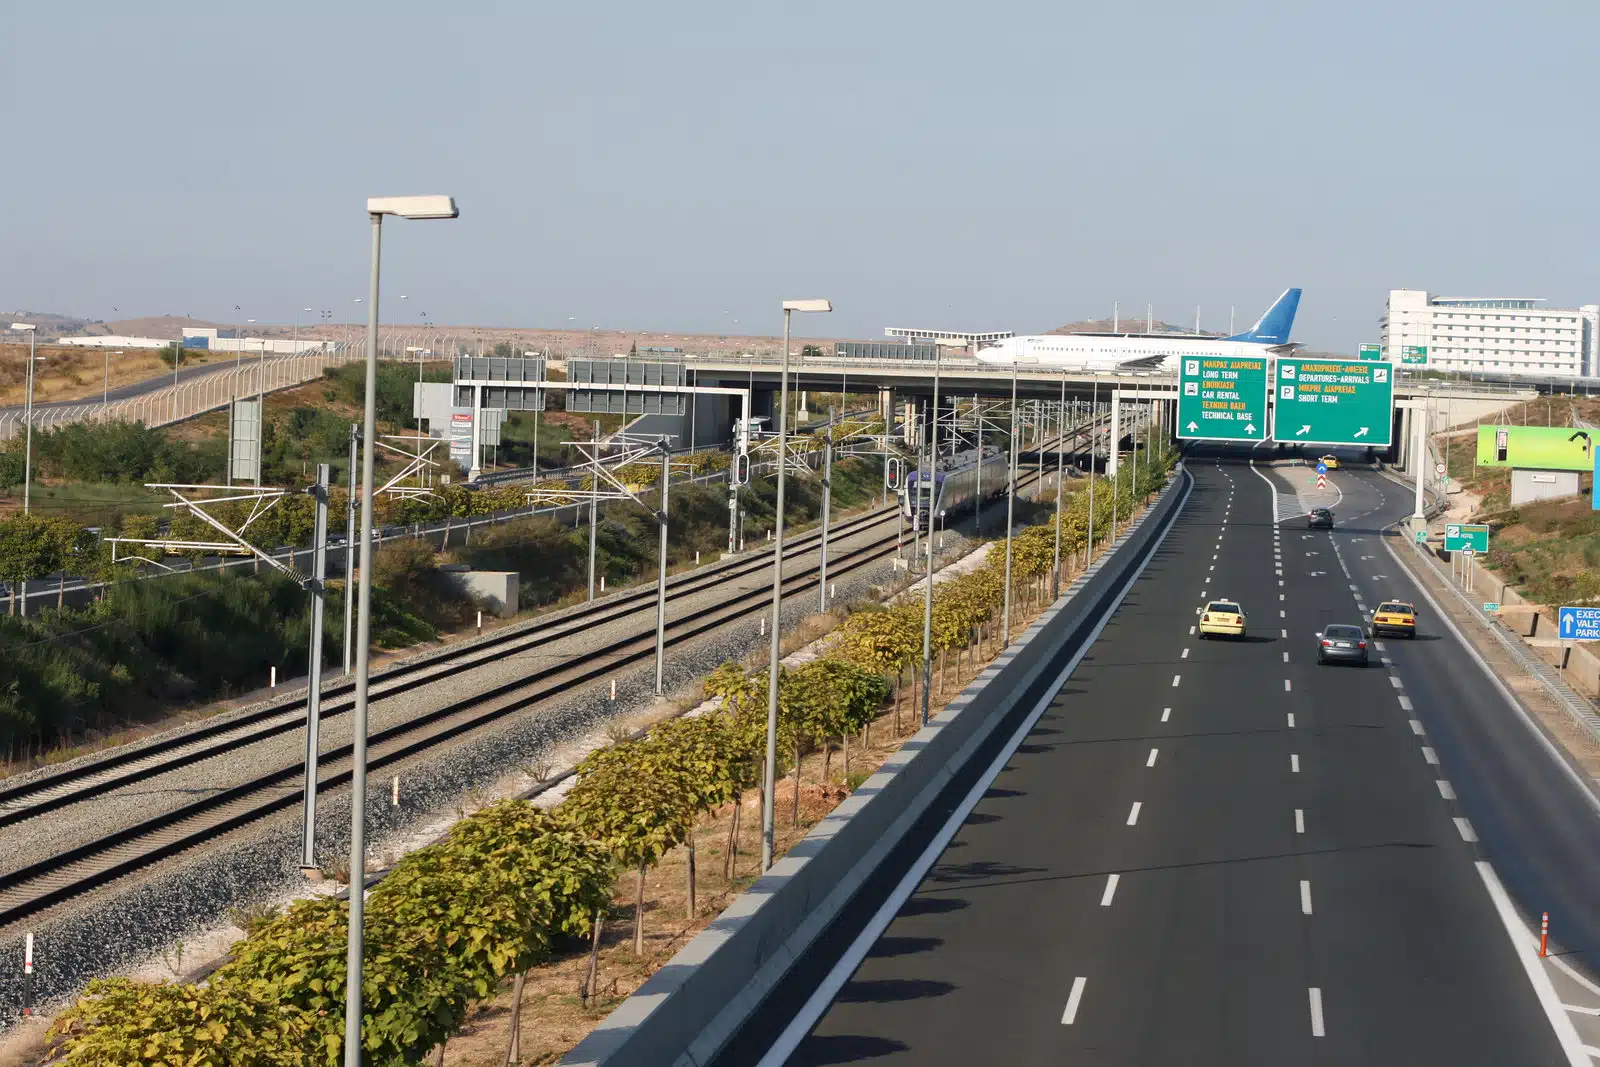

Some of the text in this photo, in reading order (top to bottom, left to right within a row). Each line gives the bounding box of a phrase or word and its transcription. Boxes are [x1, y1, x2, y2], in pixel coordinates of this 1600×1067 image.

[1203, 370, 1238, 379] LONG TERM
[1202, 391, 1240, 399] CAR RENTAL
[1298, 394, 1338, 403] SHORT TERM
[1202, 411, 1253, 420] TECHNICAL BASE
[1577, 610, 1600, 619] EXEC
[1577, 619, 1600, 628] VALE
